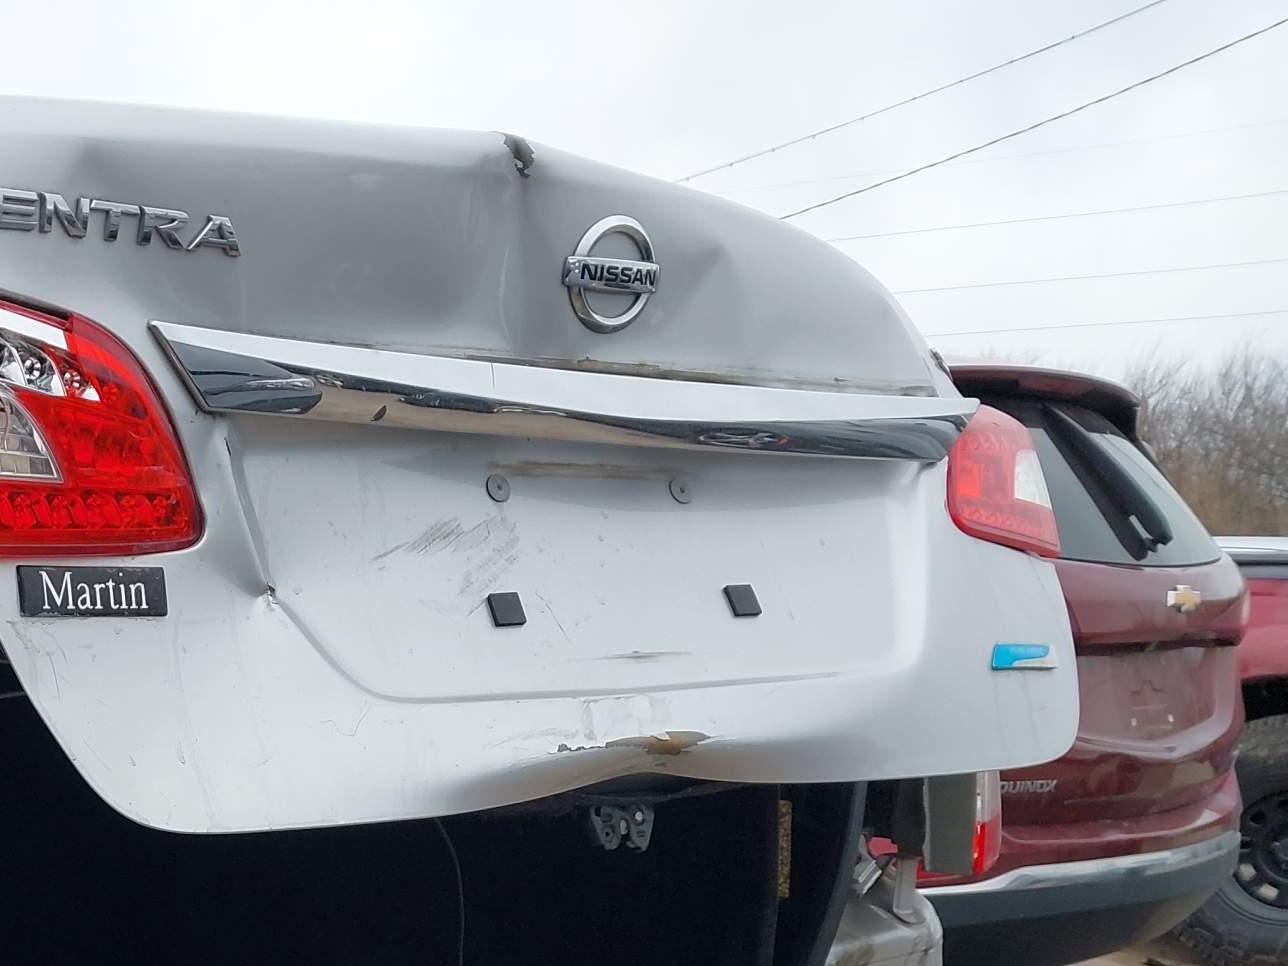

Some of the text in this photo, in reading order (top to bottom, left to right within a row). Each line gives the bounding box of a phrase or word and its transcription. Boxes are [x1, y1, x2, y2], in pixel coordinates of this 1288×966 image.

[580, 262, 657, 287] NISSAN
[39, 570, 149, 610] Martin
[1000, 780, 1058, 794] QUINOX
